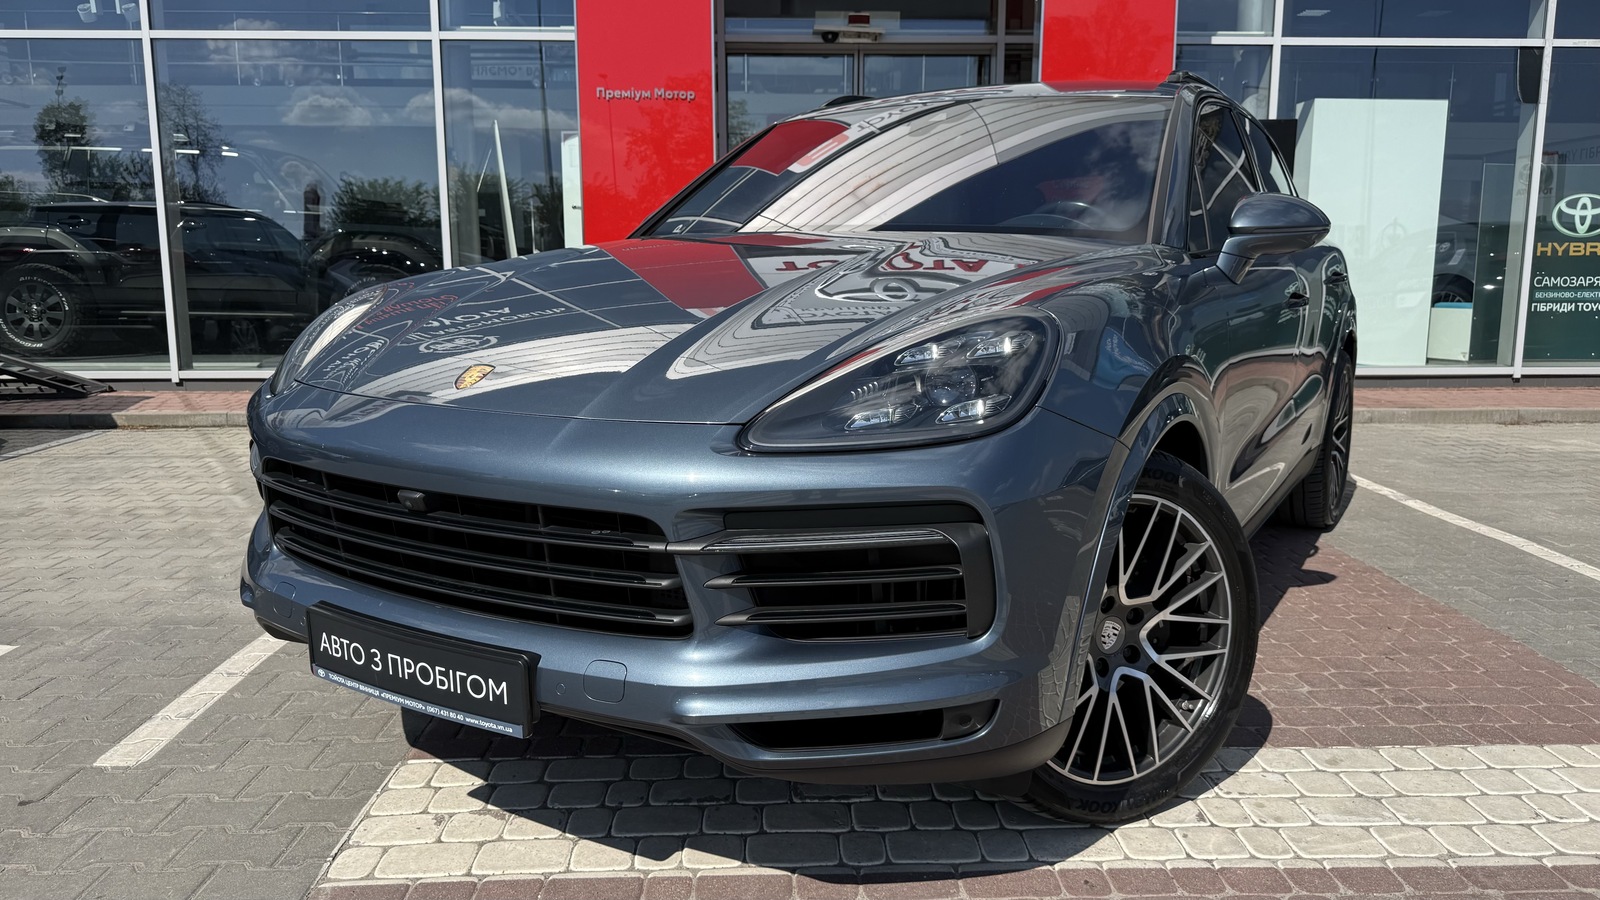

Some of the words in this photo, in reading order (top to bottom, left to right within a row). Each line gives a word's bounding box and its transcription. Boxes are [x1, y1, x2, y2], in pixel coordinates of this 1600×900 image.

[596, 87, 652, 101] Преміум
[654, 88, 695, 101] Мотор
[1536, 242, 1600, 256] HYBR
[1533, 276, 1600, 288] САМОЗАРЯ
[1531, 302, 1575, 314] ГІБРИДИ
[1577, 302, 1600, 312] TOY
[320, 632, 365, 666] АВТО
[370, 648, 383, 672] З
[387, 653, 508, 705] ПРОБІГОМ
[465, 716, 513, 733] www.toyota.vn.ua
